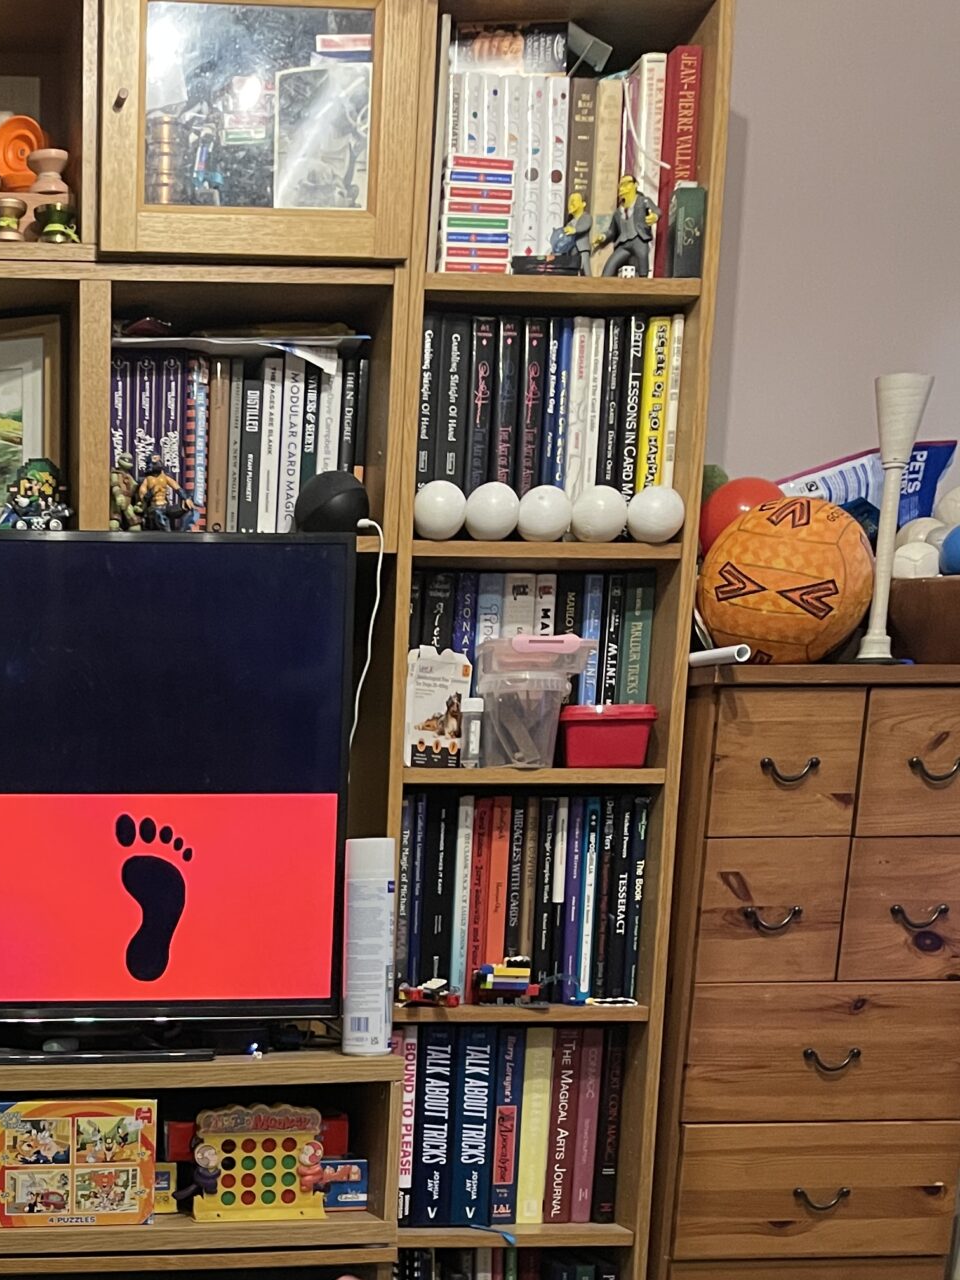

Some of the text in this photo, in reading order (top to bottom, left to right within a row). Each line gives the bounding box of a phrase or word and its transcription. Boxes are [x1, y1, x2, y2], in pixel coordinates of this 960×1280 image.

[676, 53, 696, 132] JEAN-PIERRE
[633, 321, 644, 357] ORTIZ
[346, 372, 355, 388] THE
[652, 326, 668, 398] SECRETS OF
[246, 391, 259, 432] DISTILLED
[625, 373, 641, 429] LESSONS
[284, 372, 300, 521] MODULAR CARD MAGIC
[304, 424, 315, 453] SECRETS
[323, 417, 332, 455] Campbell
[606, 431, 614, 458] DARWIN
[625, 432, 636, 443] IN
[622, 446, 635, 480] CARD
[907, 450, 928, 493] PETS
[605, 643, 617, 687] M.I.N.T.
[401, 848, 409, 871] Magic
[401, 874, 409, 882] of
[509, 809, 523, 926] MIRACLES WITH CARDS
[399, 885, 408, 916] Michael
[634, 860, 645, 901] The Book
[616, 873, 628, 935] TESSERACT
[503, 1036, 516, 1103] Harry Lorayne's
[400, 1042, 416, 1175] BOUND TO PLEASE
[422, 1045, 451, 1164] TALK ABOUT TRICKS
[460, 1045, 490, 1164] TALK ABOUT TRICKS
[550, 1041, 576, 1218] THE MAGICAL ARTS JOURNAL
[57, 1216, 96, 1224] PUZZLES
[493, 1203, 511, 1213] L&L
